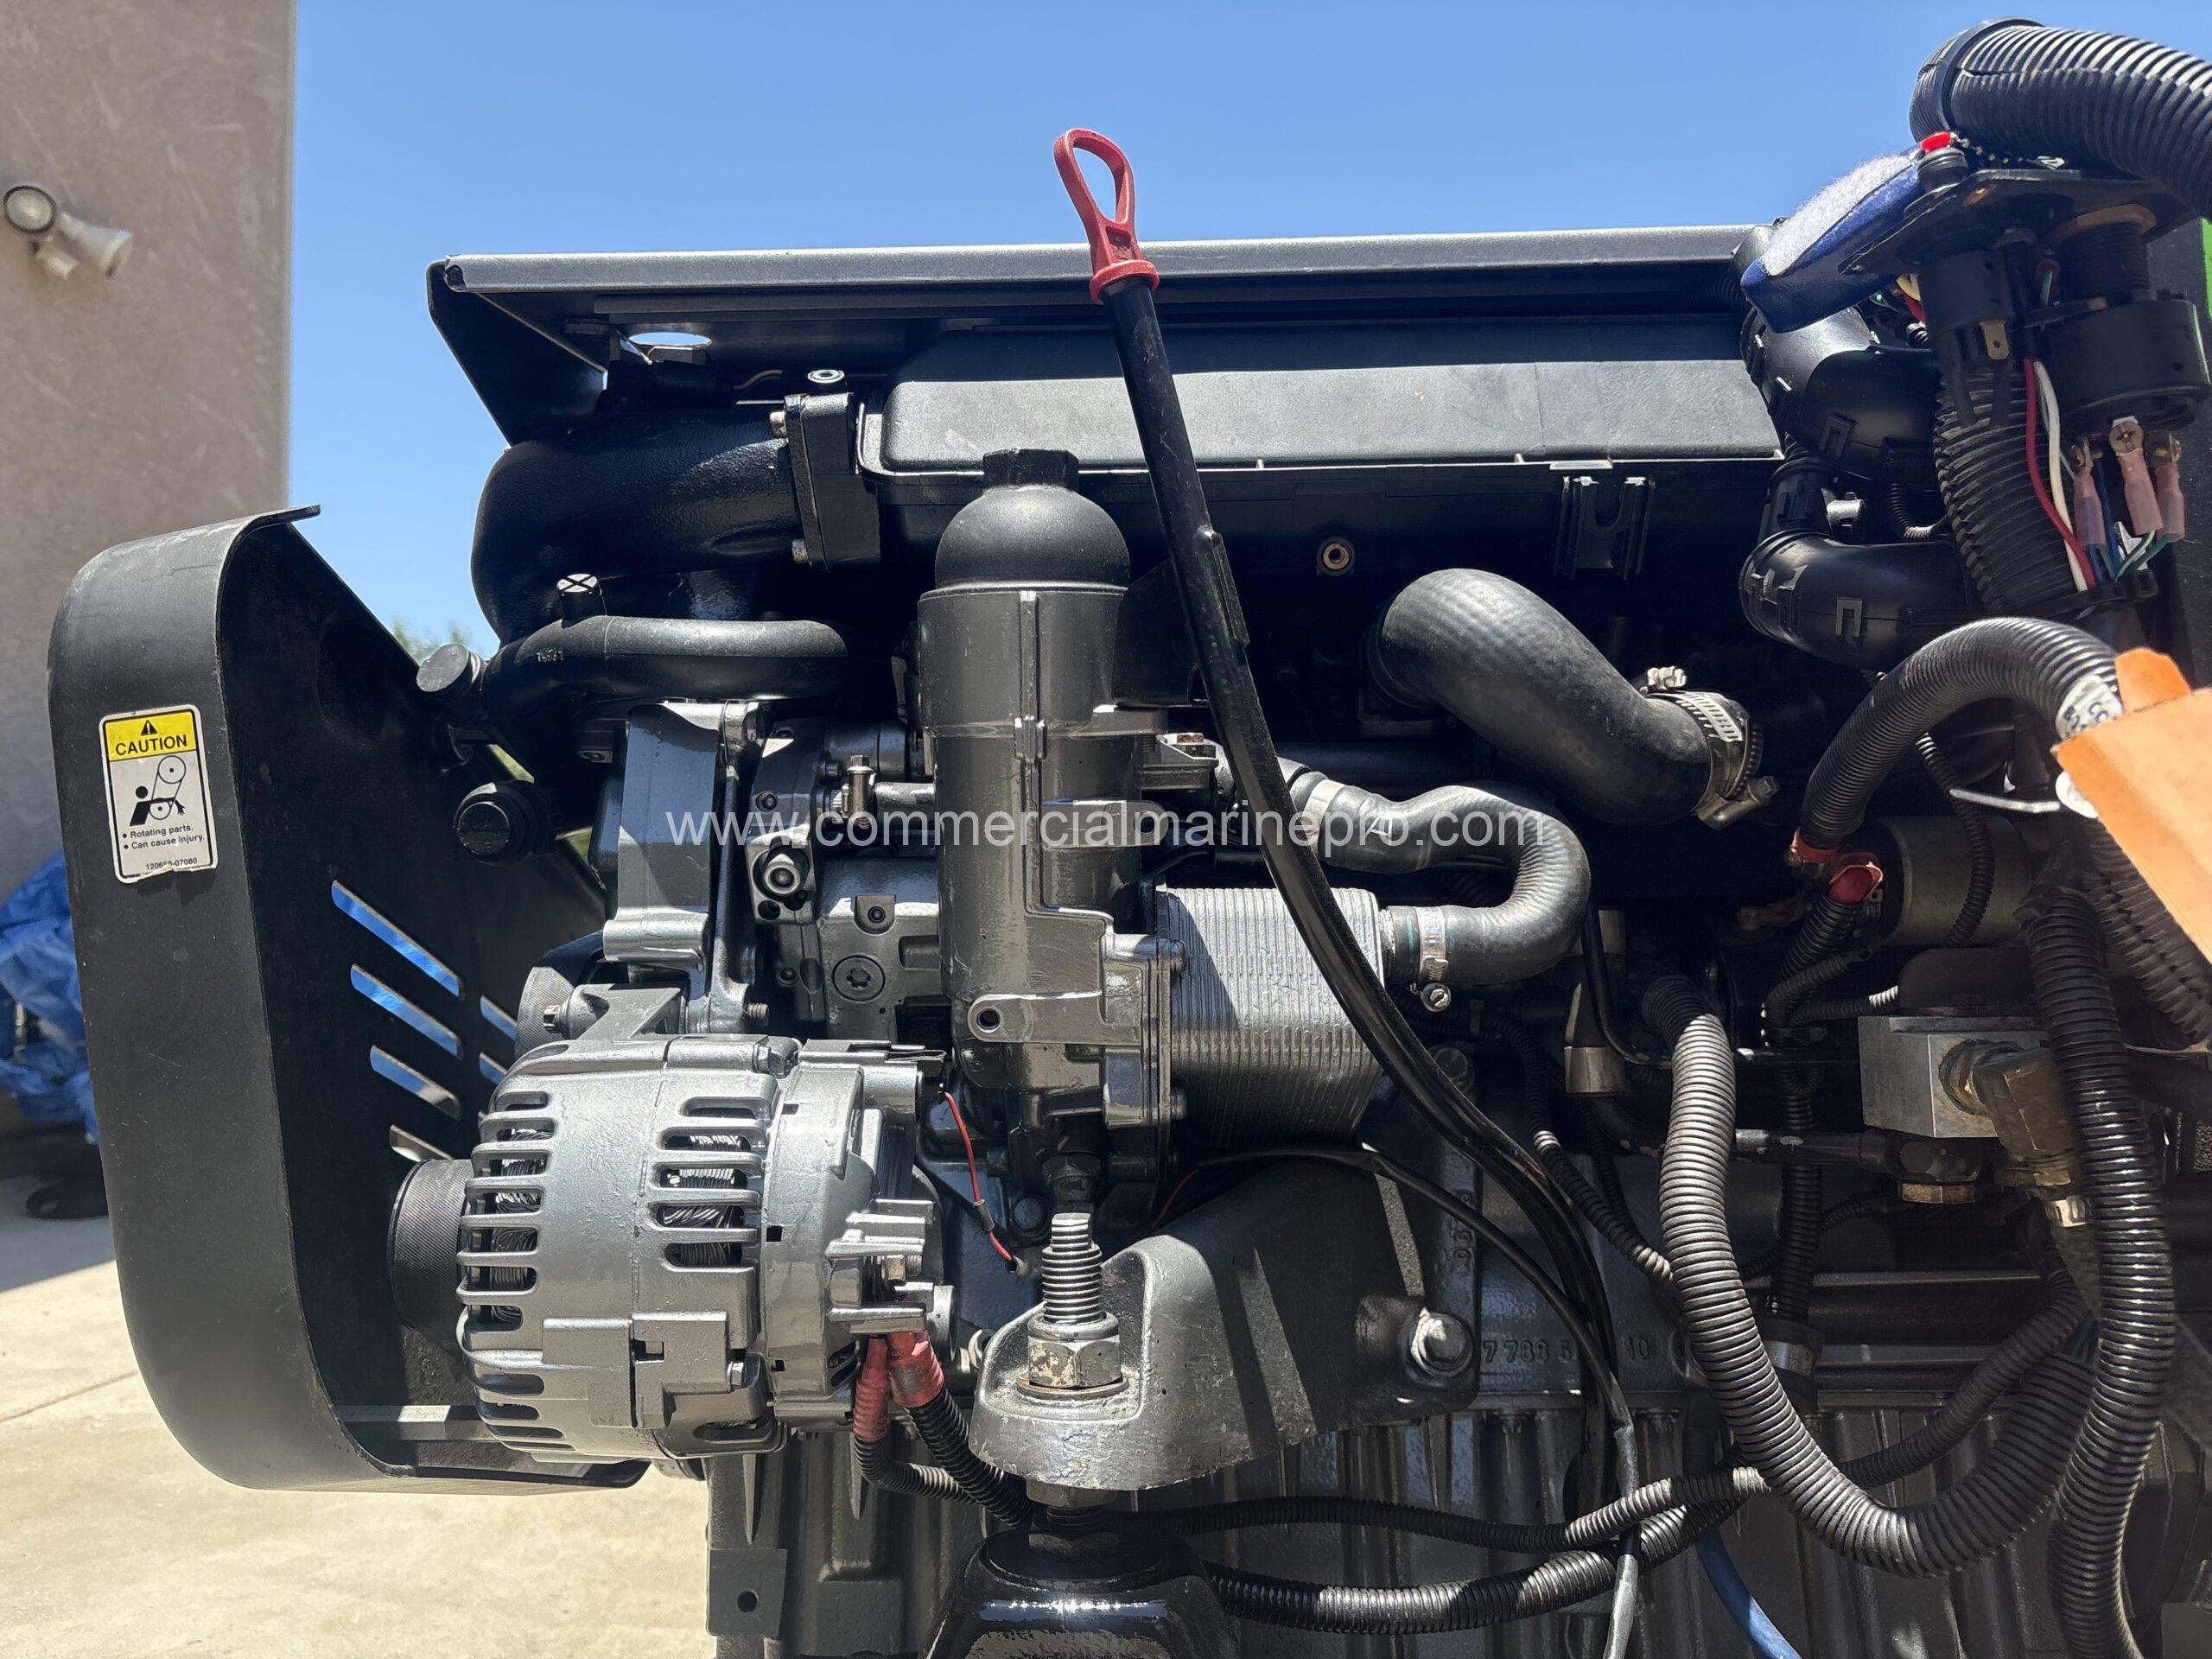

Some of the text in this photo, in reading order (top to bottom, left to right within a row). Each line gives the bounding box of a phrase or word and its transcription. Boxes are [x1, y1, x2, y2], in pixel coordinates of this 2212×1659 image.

[115, 734, 188, 756] CAUTION
[130, 823, 194, 839] Rotating parts.
[131, 834, 206, 849] Can cause injury.
